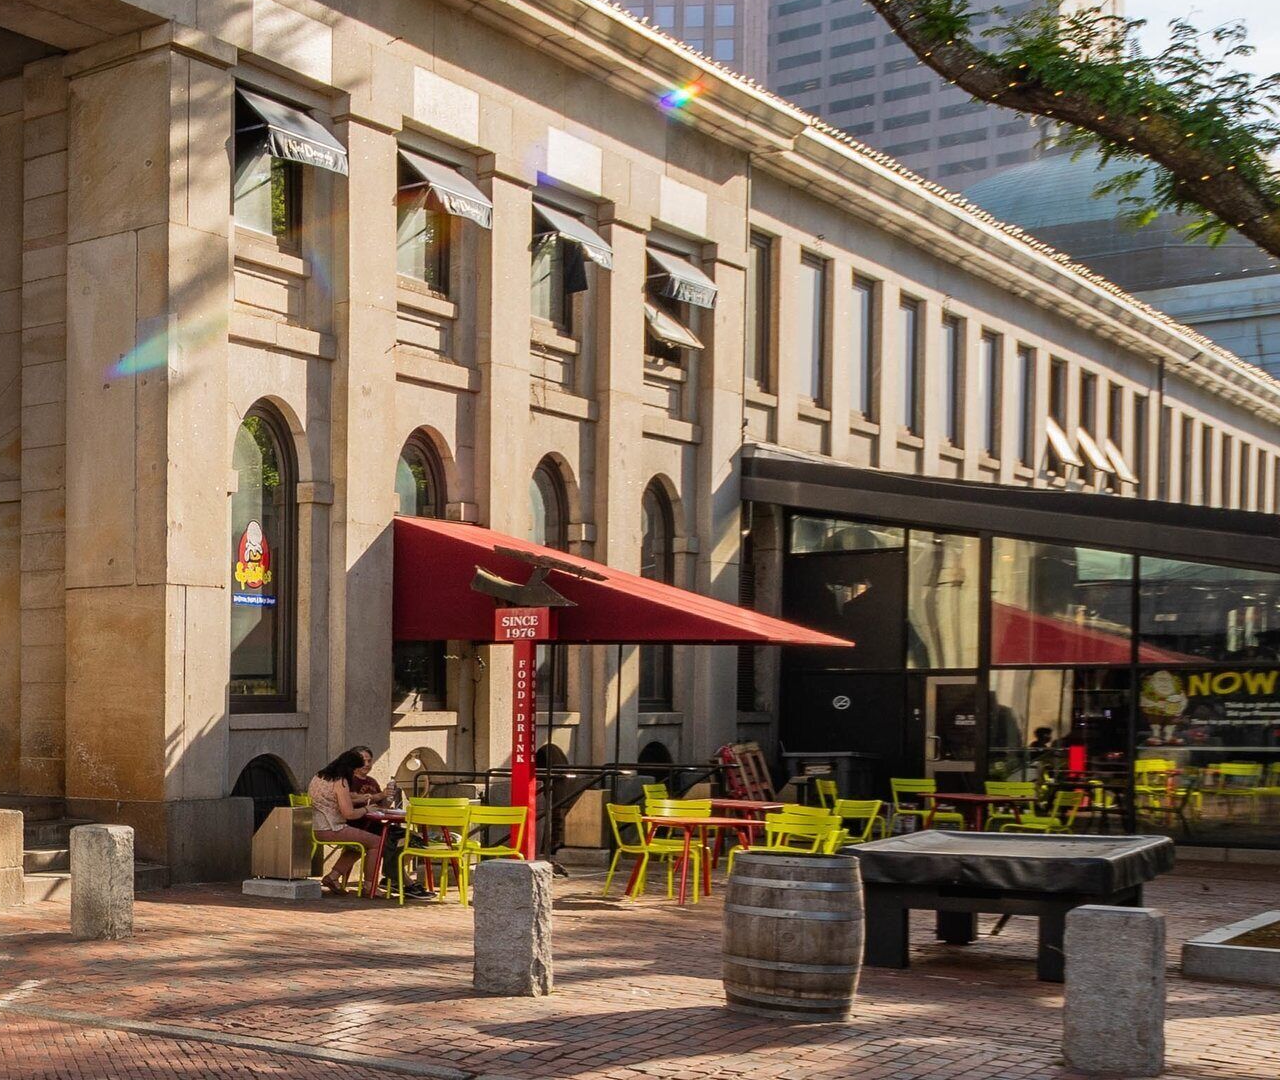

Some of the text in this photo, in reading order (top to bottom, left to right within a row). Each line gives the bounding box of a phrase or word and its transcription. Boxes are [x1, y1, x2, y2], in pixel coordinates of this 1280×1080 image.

[501, 615, 539, 627] SINCE
[505, 627, 536, 639] 1976
[1188, 670, 1280, 696] NOW
[515, 660, 527, 763] FOOD DRINK
